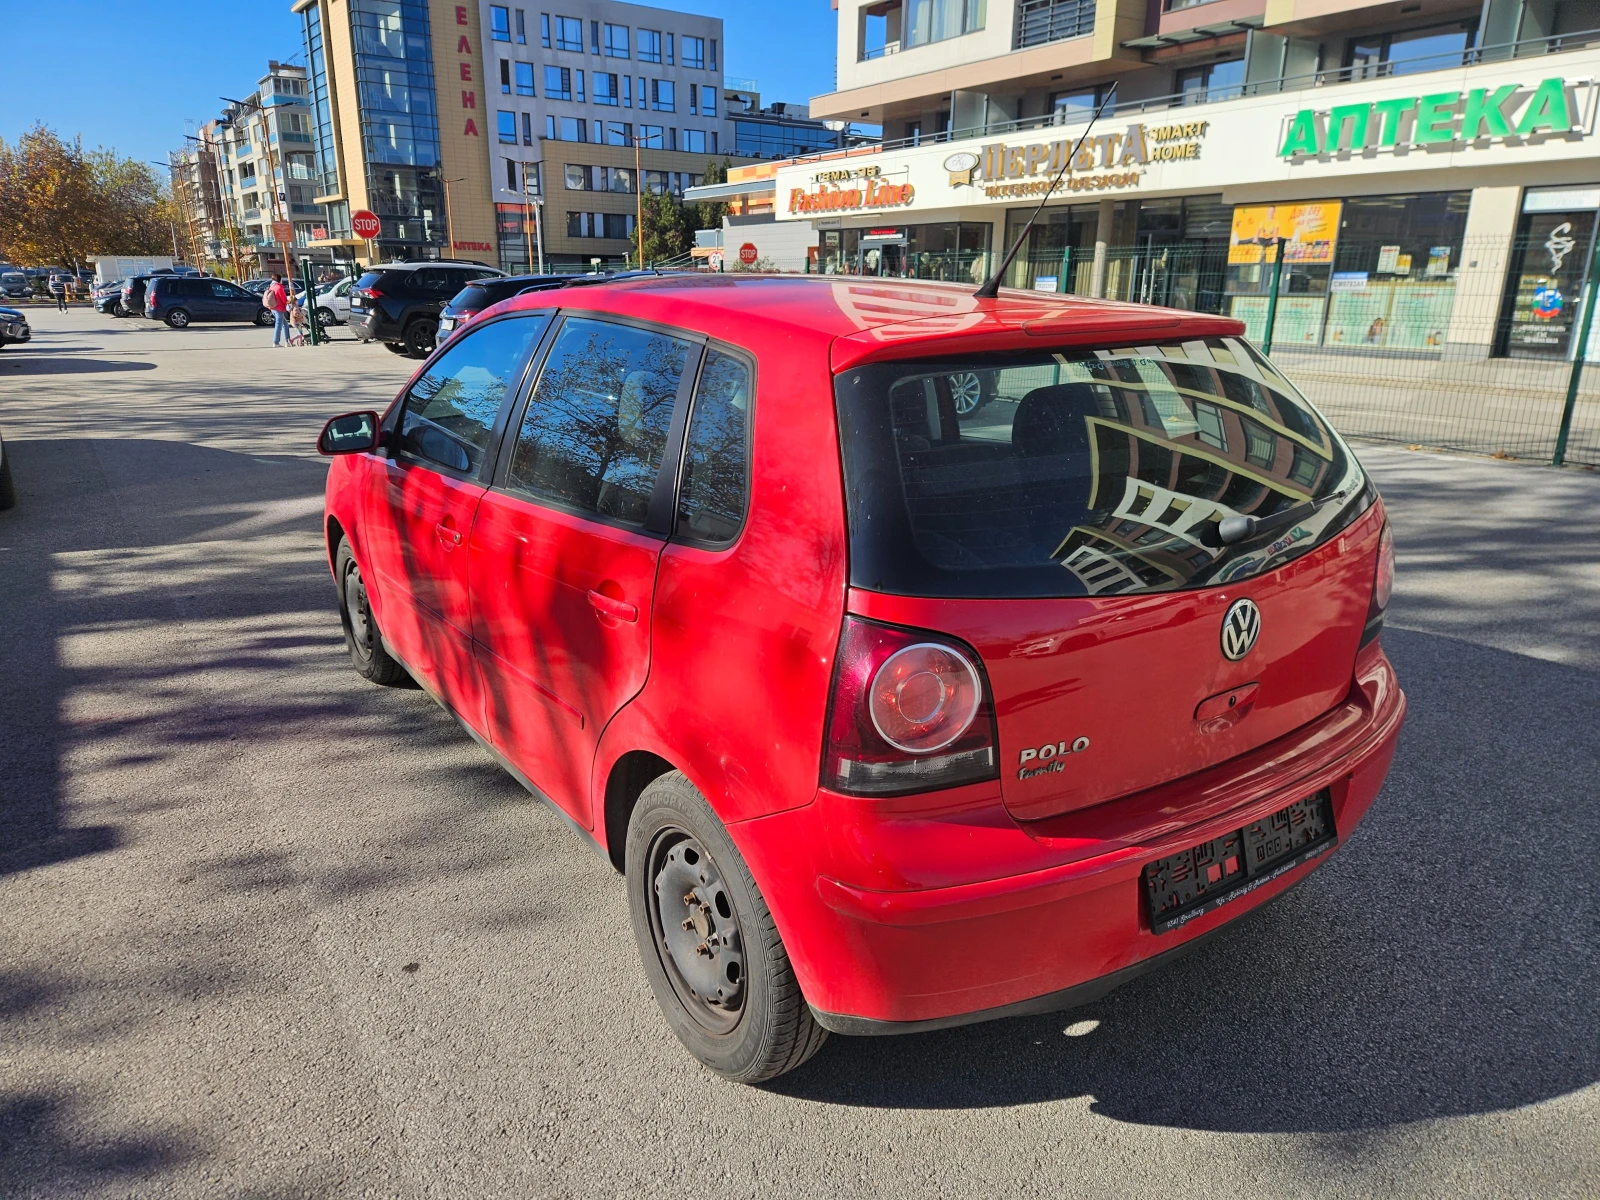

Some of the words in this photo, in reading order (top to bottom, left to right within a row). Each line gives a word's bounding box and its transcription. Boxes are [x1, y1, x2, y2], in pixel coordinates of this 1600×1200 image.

[456, 6, 478, 136] ЕЛЕНА
[1279, 77, 1571, 158] АПТЕКА
[1149, 121, 1206, 142] SMART
[981, 124, 1148, 180] ПЕРДЕТА
[1151, 143, 1197, 161] HOME
[788, 185, 861, 213] Fashion
[863, 178, 913, 206] Line
[985, 177, 1063, 197] INTERIOR
[1067, 172, 1139, 190] DESIGN
[354, 218, 378, 230] STOP
[453, 241, 492, 252] АПТЕКА
[740, 249, 757, 259] STOP
[1019, 736, 1090, 765] POLO
